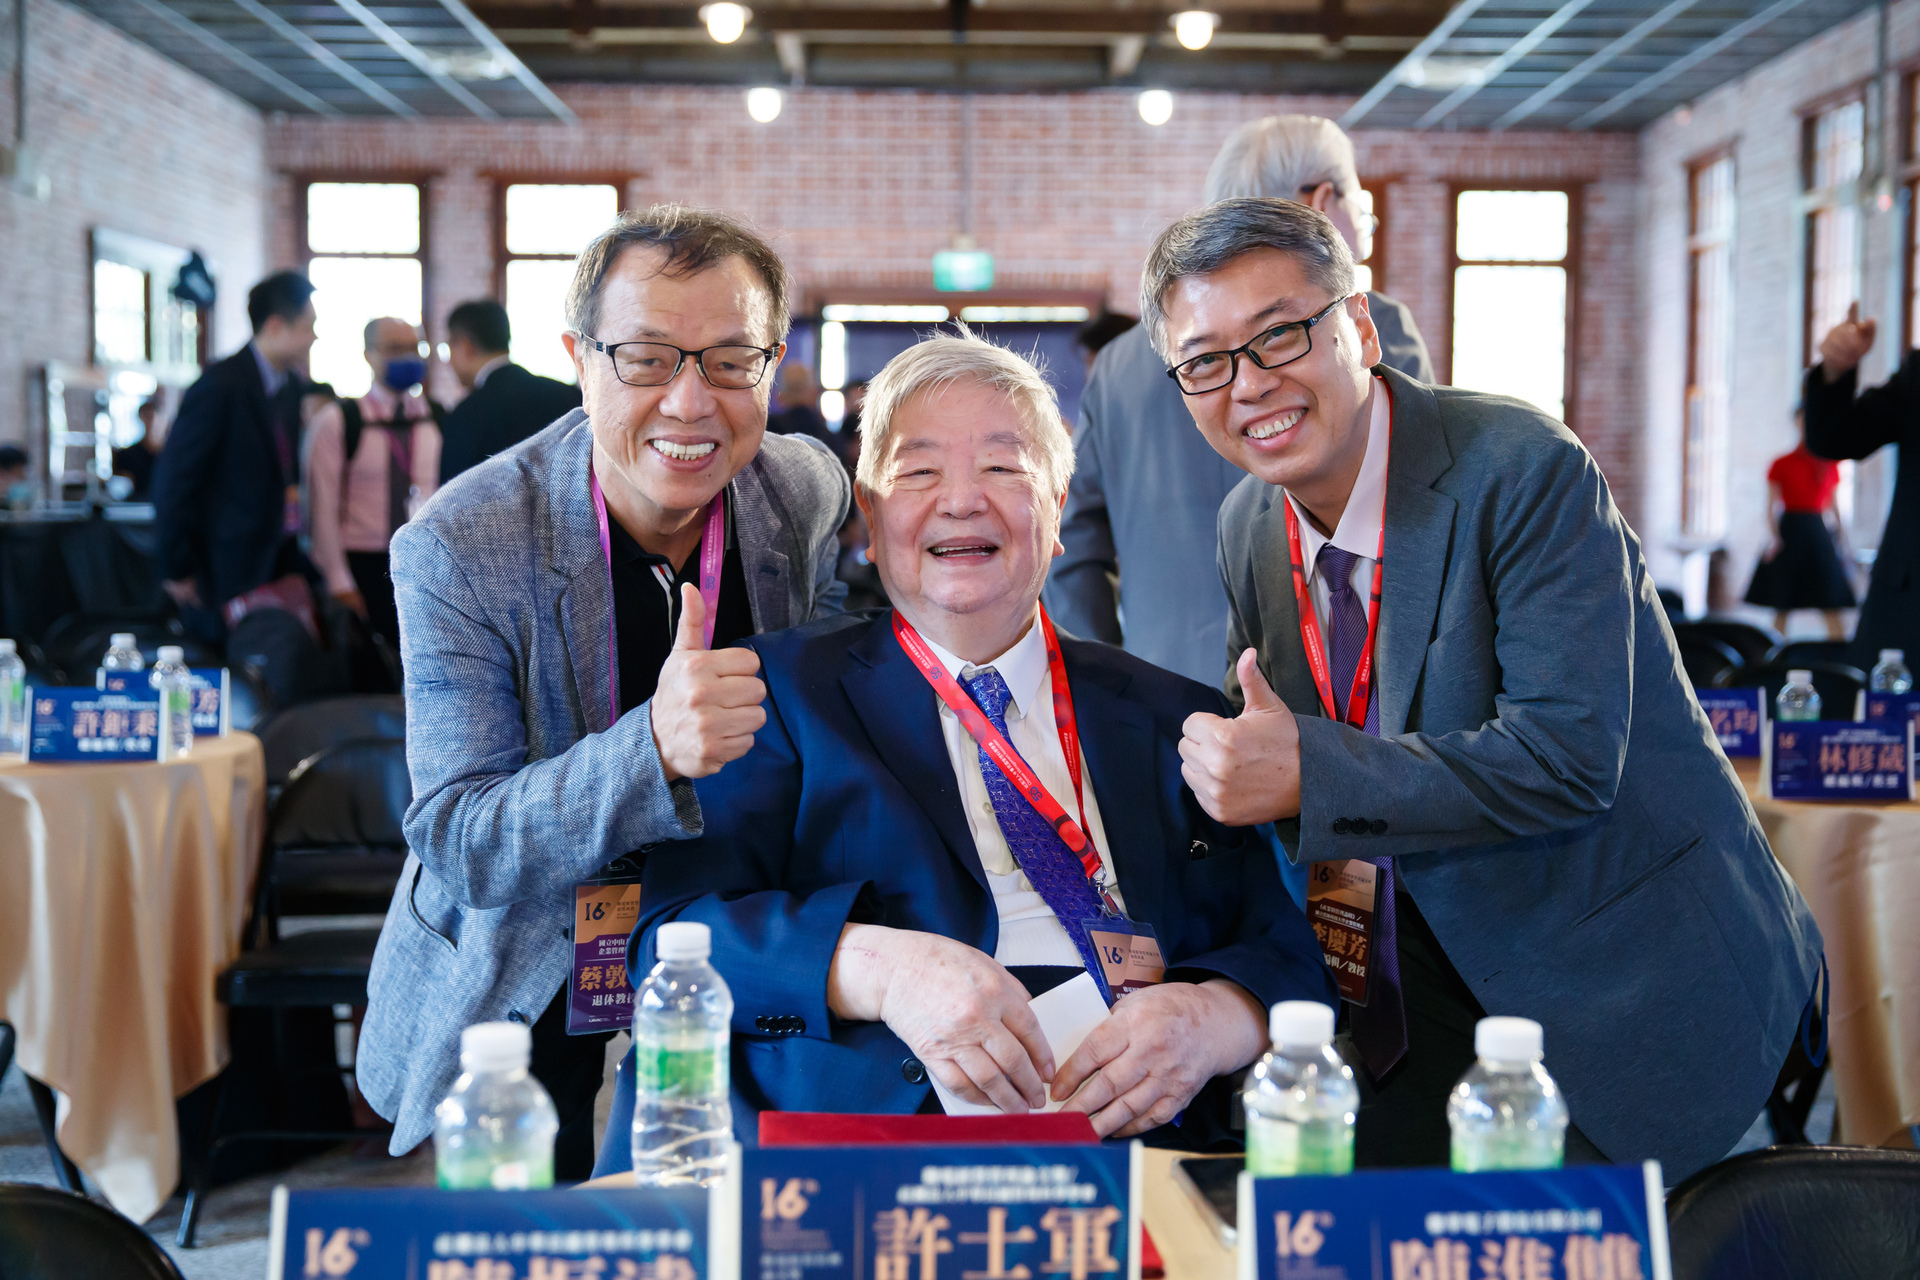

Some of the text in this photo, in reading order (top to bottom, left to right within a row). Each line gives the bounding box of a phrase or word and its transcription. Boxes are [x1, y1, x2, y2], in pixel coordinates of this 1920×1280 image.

[1004, 753, 1023, 774] Management
[1020, 772, 1033, 786] Chinese
[598, 946, 627, 956] 企業管理
[872, 1205, 1121, 1280] 許士軍
